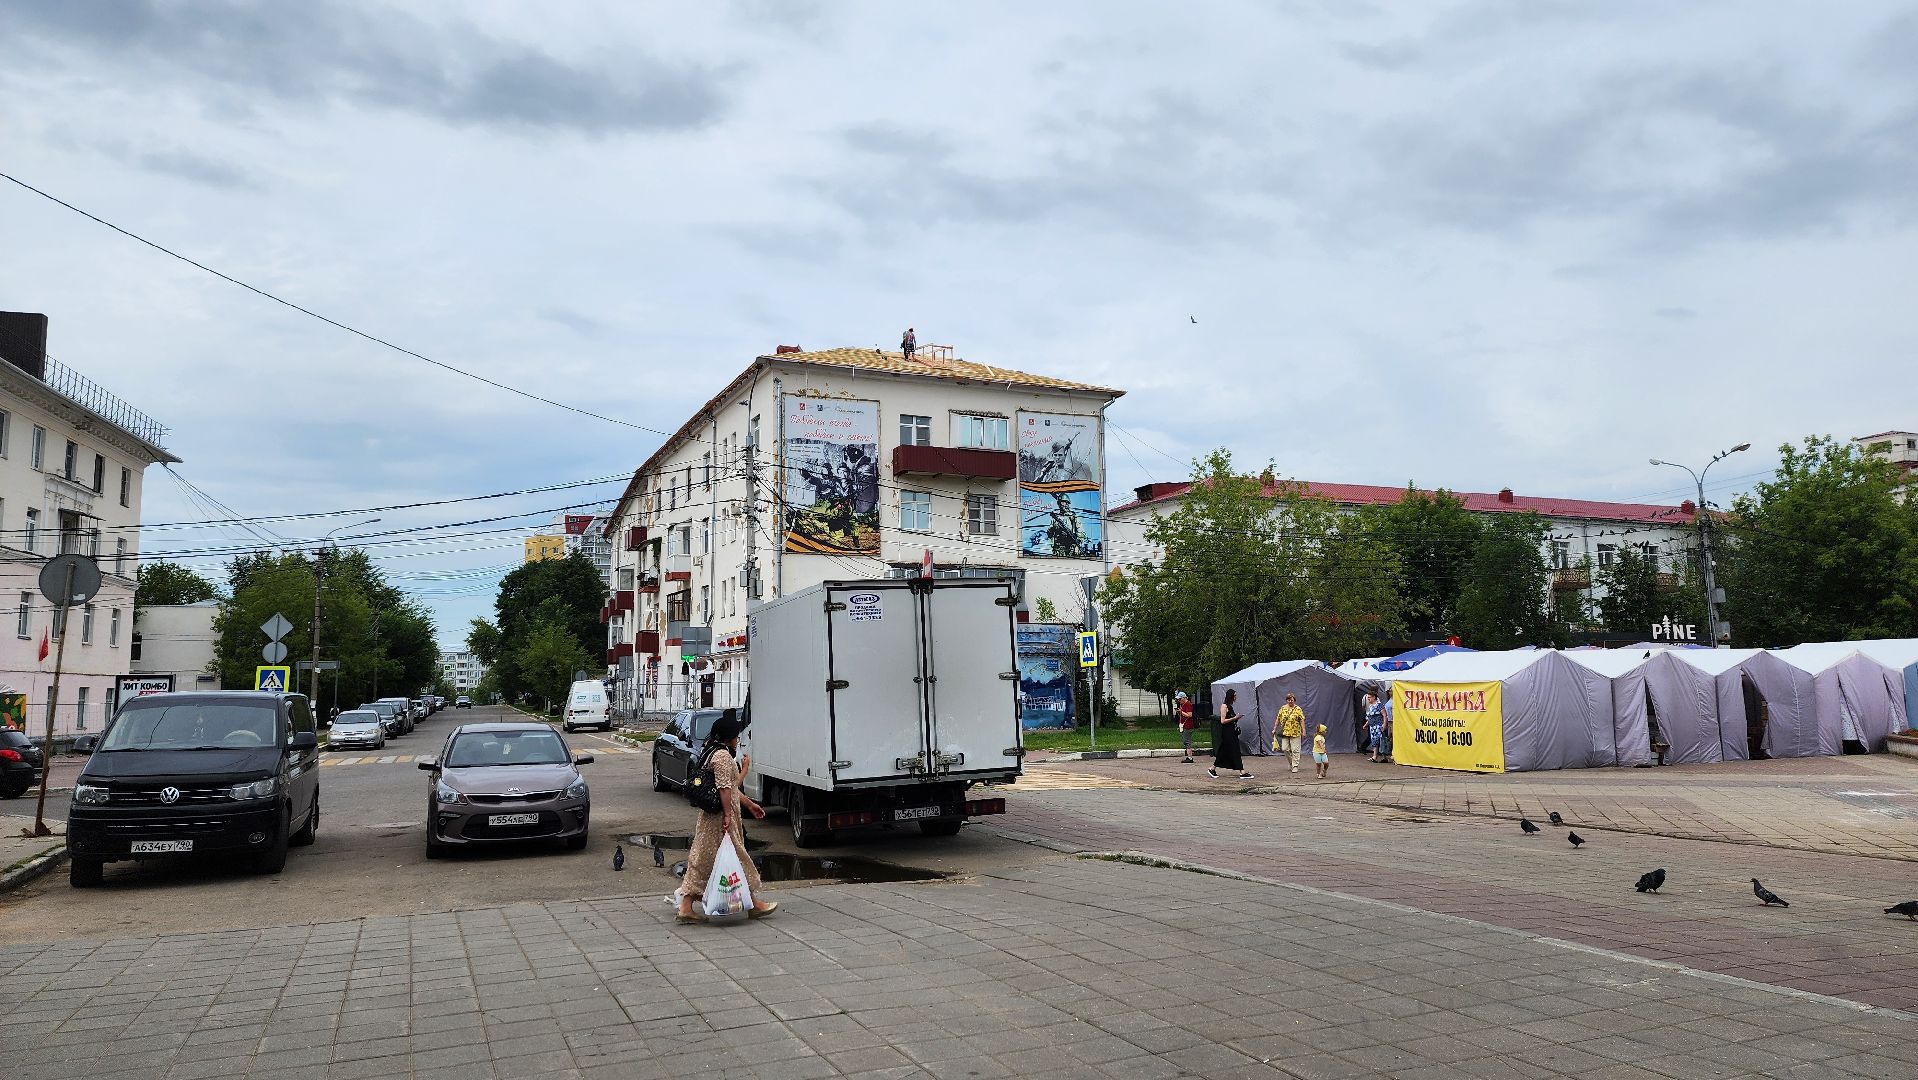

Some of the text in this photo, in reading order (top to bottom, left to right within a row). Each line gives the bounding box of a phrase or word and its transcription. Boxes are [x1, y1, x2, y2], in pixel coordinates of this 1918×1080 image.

[1652, 615, 1697, 640] PINE
[1403, 690, 1487, 711] ЯРМАРКА
[1420, 716, 1466, 729] Часы работы:
[1415, 729, 1438, 744] 09:00
[1447, 731, 1472, 746] 18:00
